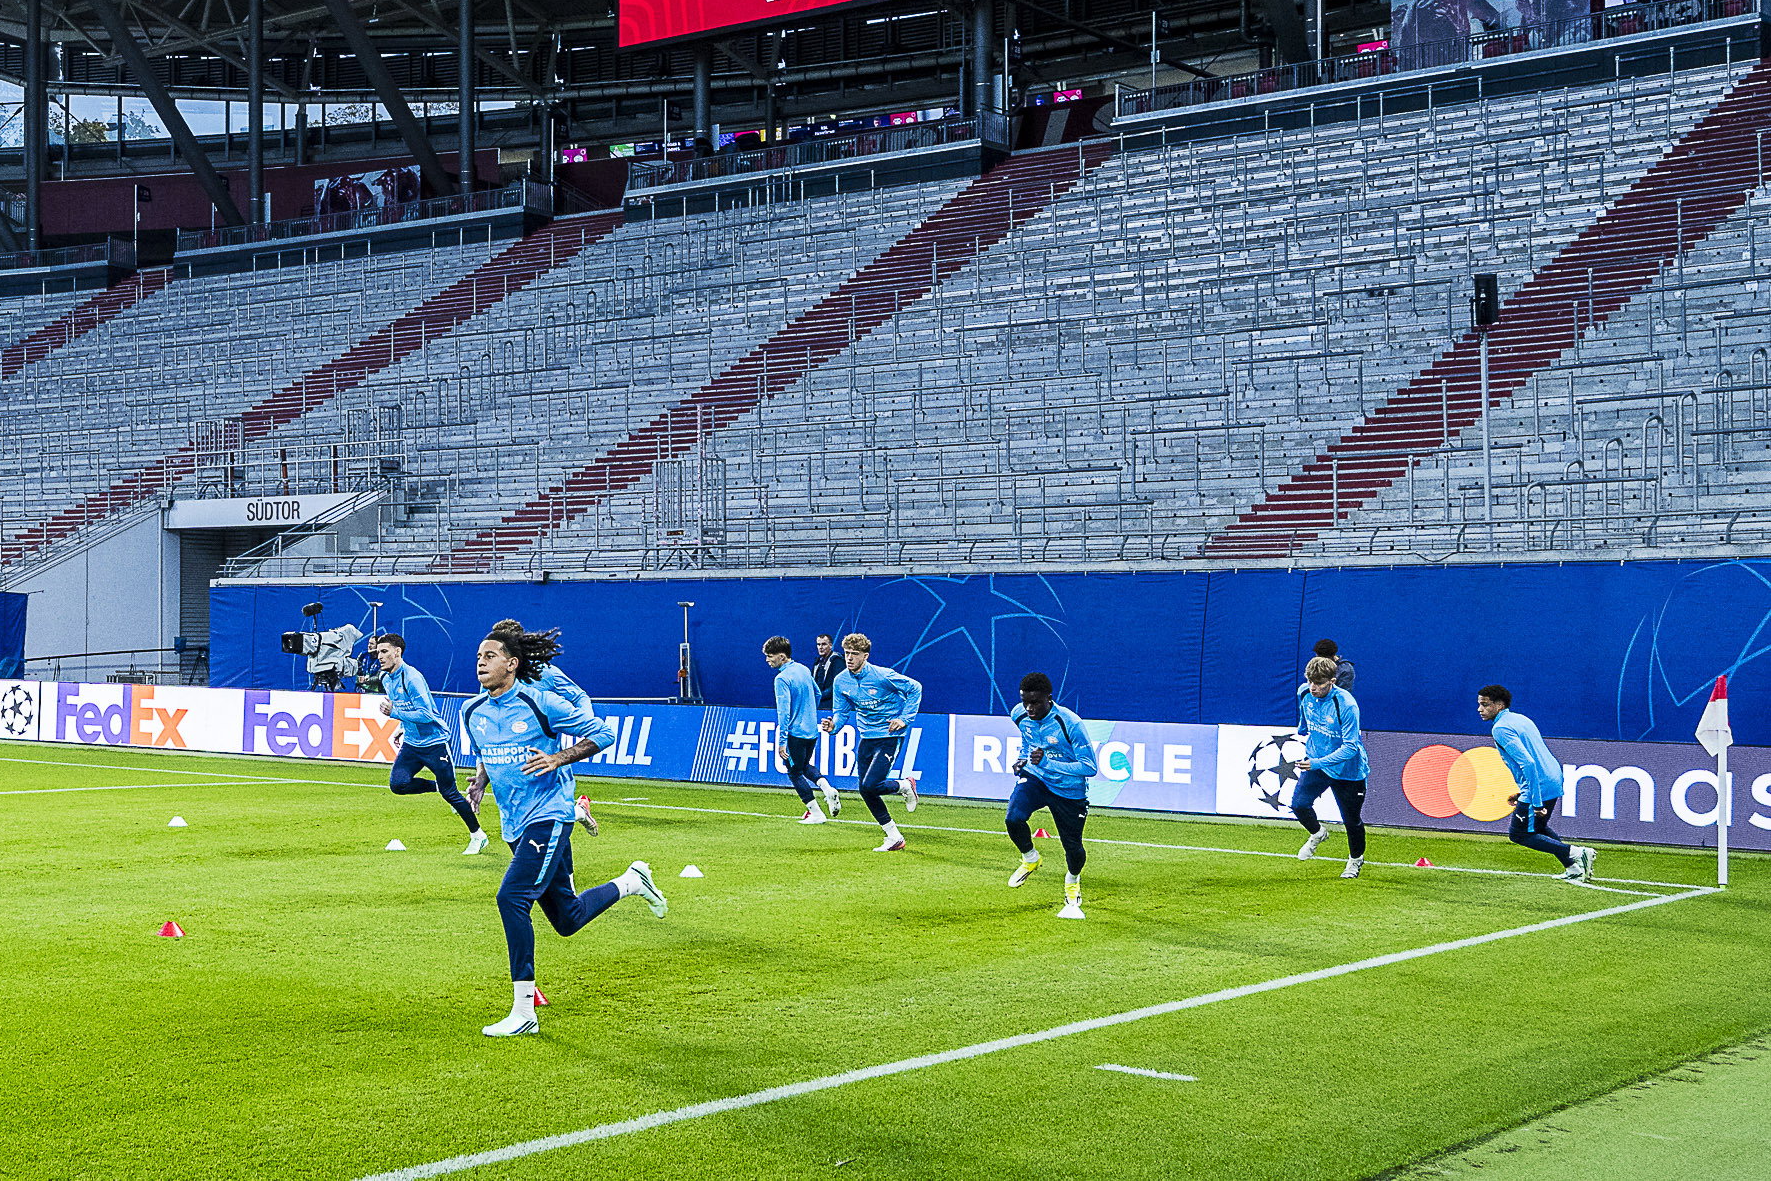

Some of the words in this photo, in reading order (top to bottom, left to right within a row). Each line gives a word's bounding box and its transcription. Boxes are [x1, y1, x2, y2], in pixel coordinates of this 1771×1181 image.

[246, 499, 301, 522] SÜDTOR
[56, 683, 189, 748] FedEx
[242, 689, 401, 762] FedEx
